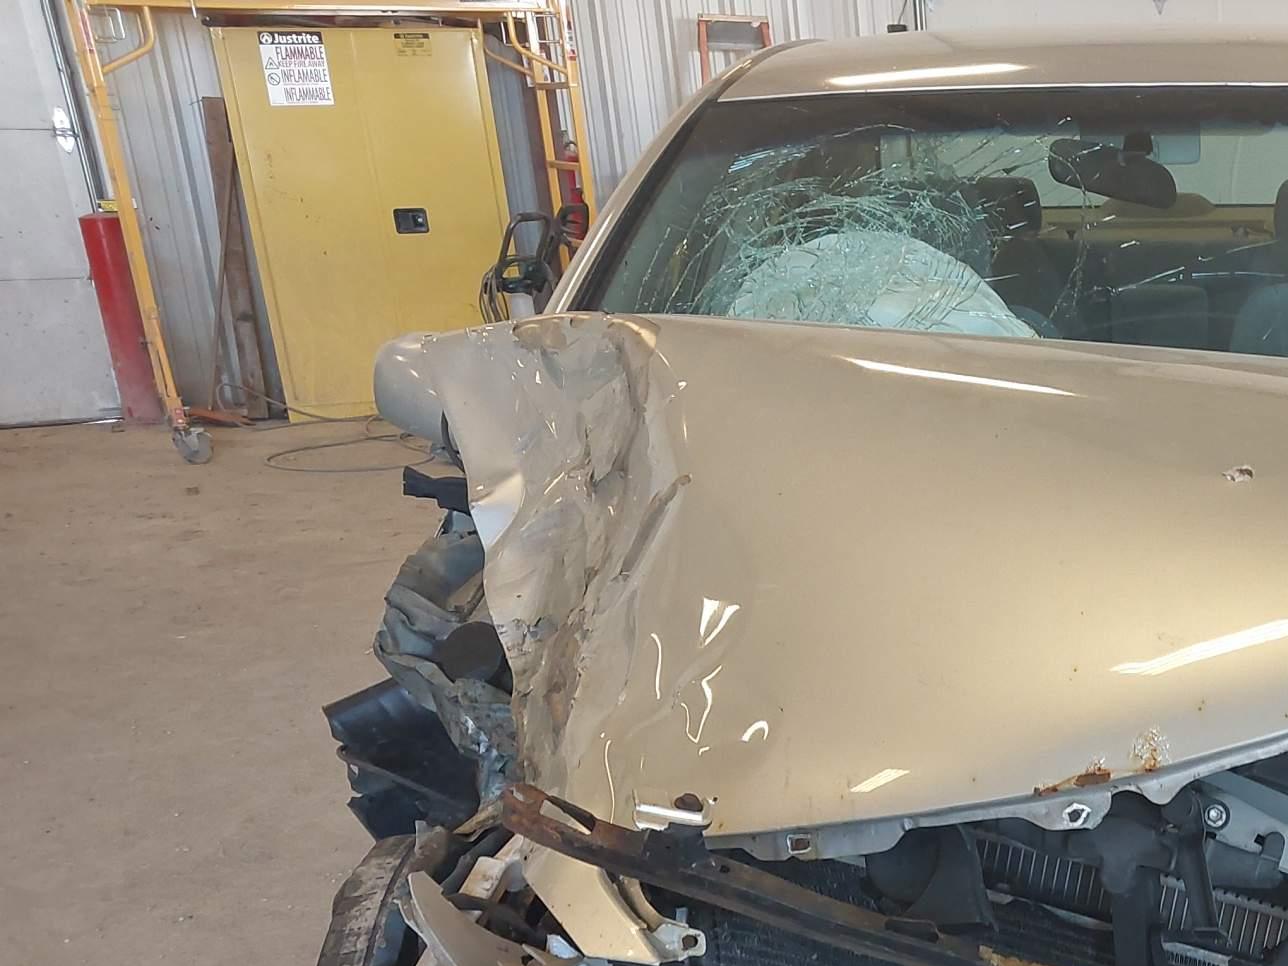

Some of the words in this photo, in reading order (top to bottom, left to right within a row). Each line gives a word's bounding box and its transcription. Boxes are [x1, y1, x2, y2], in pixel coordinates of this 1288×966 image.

[273, 32, 320, 44] Justrite
[275, 46, 324, 60] FLAMMABLE
[278, 60, 293, 68] KEEP
[294, 60, 307, 68] FIRE
[308, 60, 325, 68] AWAY
[281, 68, 328, 83] INFLAMABLE
[284, 87, 331, 101] INFLAMMABLE
